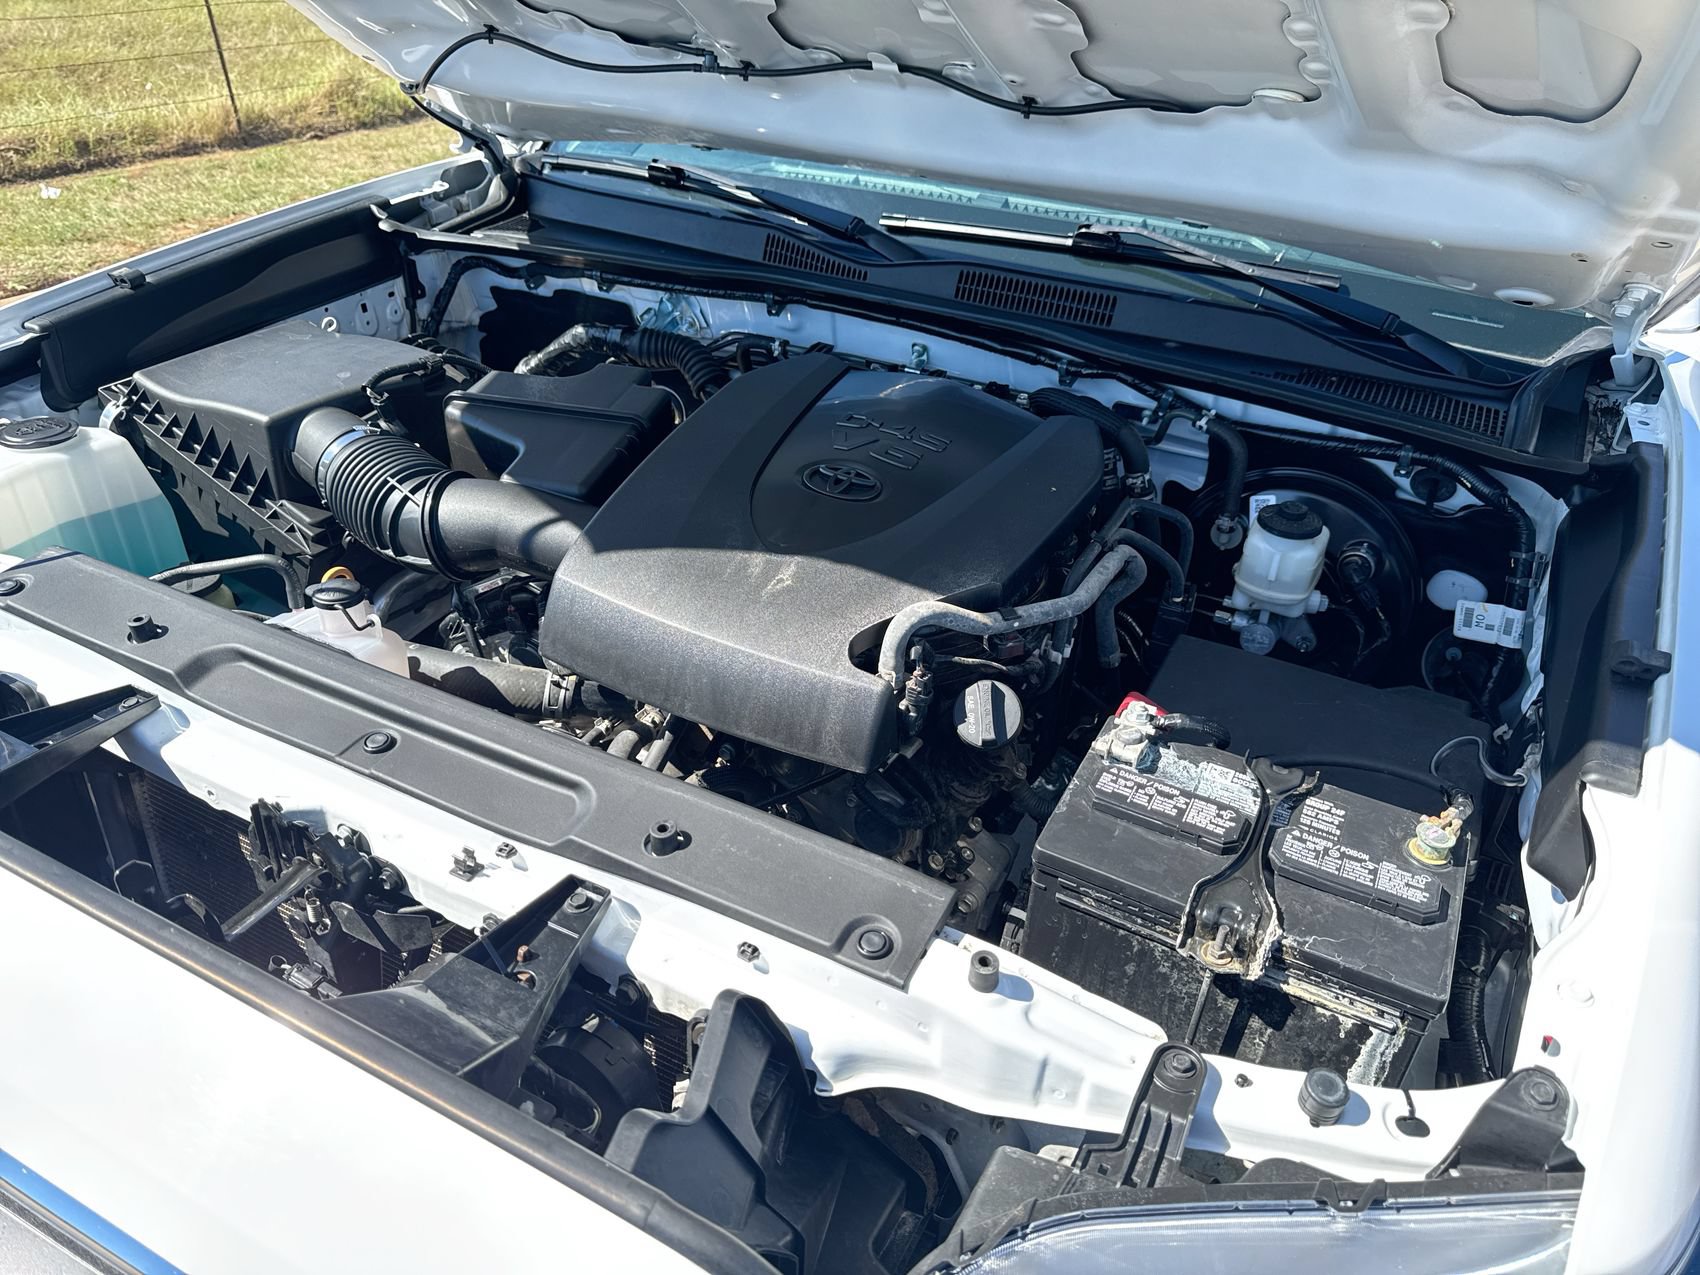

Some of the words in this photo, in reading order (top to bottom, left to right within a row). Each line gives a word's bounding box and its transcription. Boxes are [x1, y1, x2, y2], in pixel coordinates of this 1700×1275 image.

[831, 428, 925, 471] V6
[1475, 614, 1486, 628] MO
[967, 695, 975, 709] SAE
[967, 712, 976, 734] 0W-20
[1119, 769, 1148, 785] DANGER
[1153, 782, 1181, 796] POISON
[1305, 798, 1331, 811] GROUP
[1317, 813, 1340, 825] AMPS
[1311, 821, 1341, 836] MINUTES
[1302, 832, 1334, 849] DANGER
[1340, 846, 1369, 860] POISON
